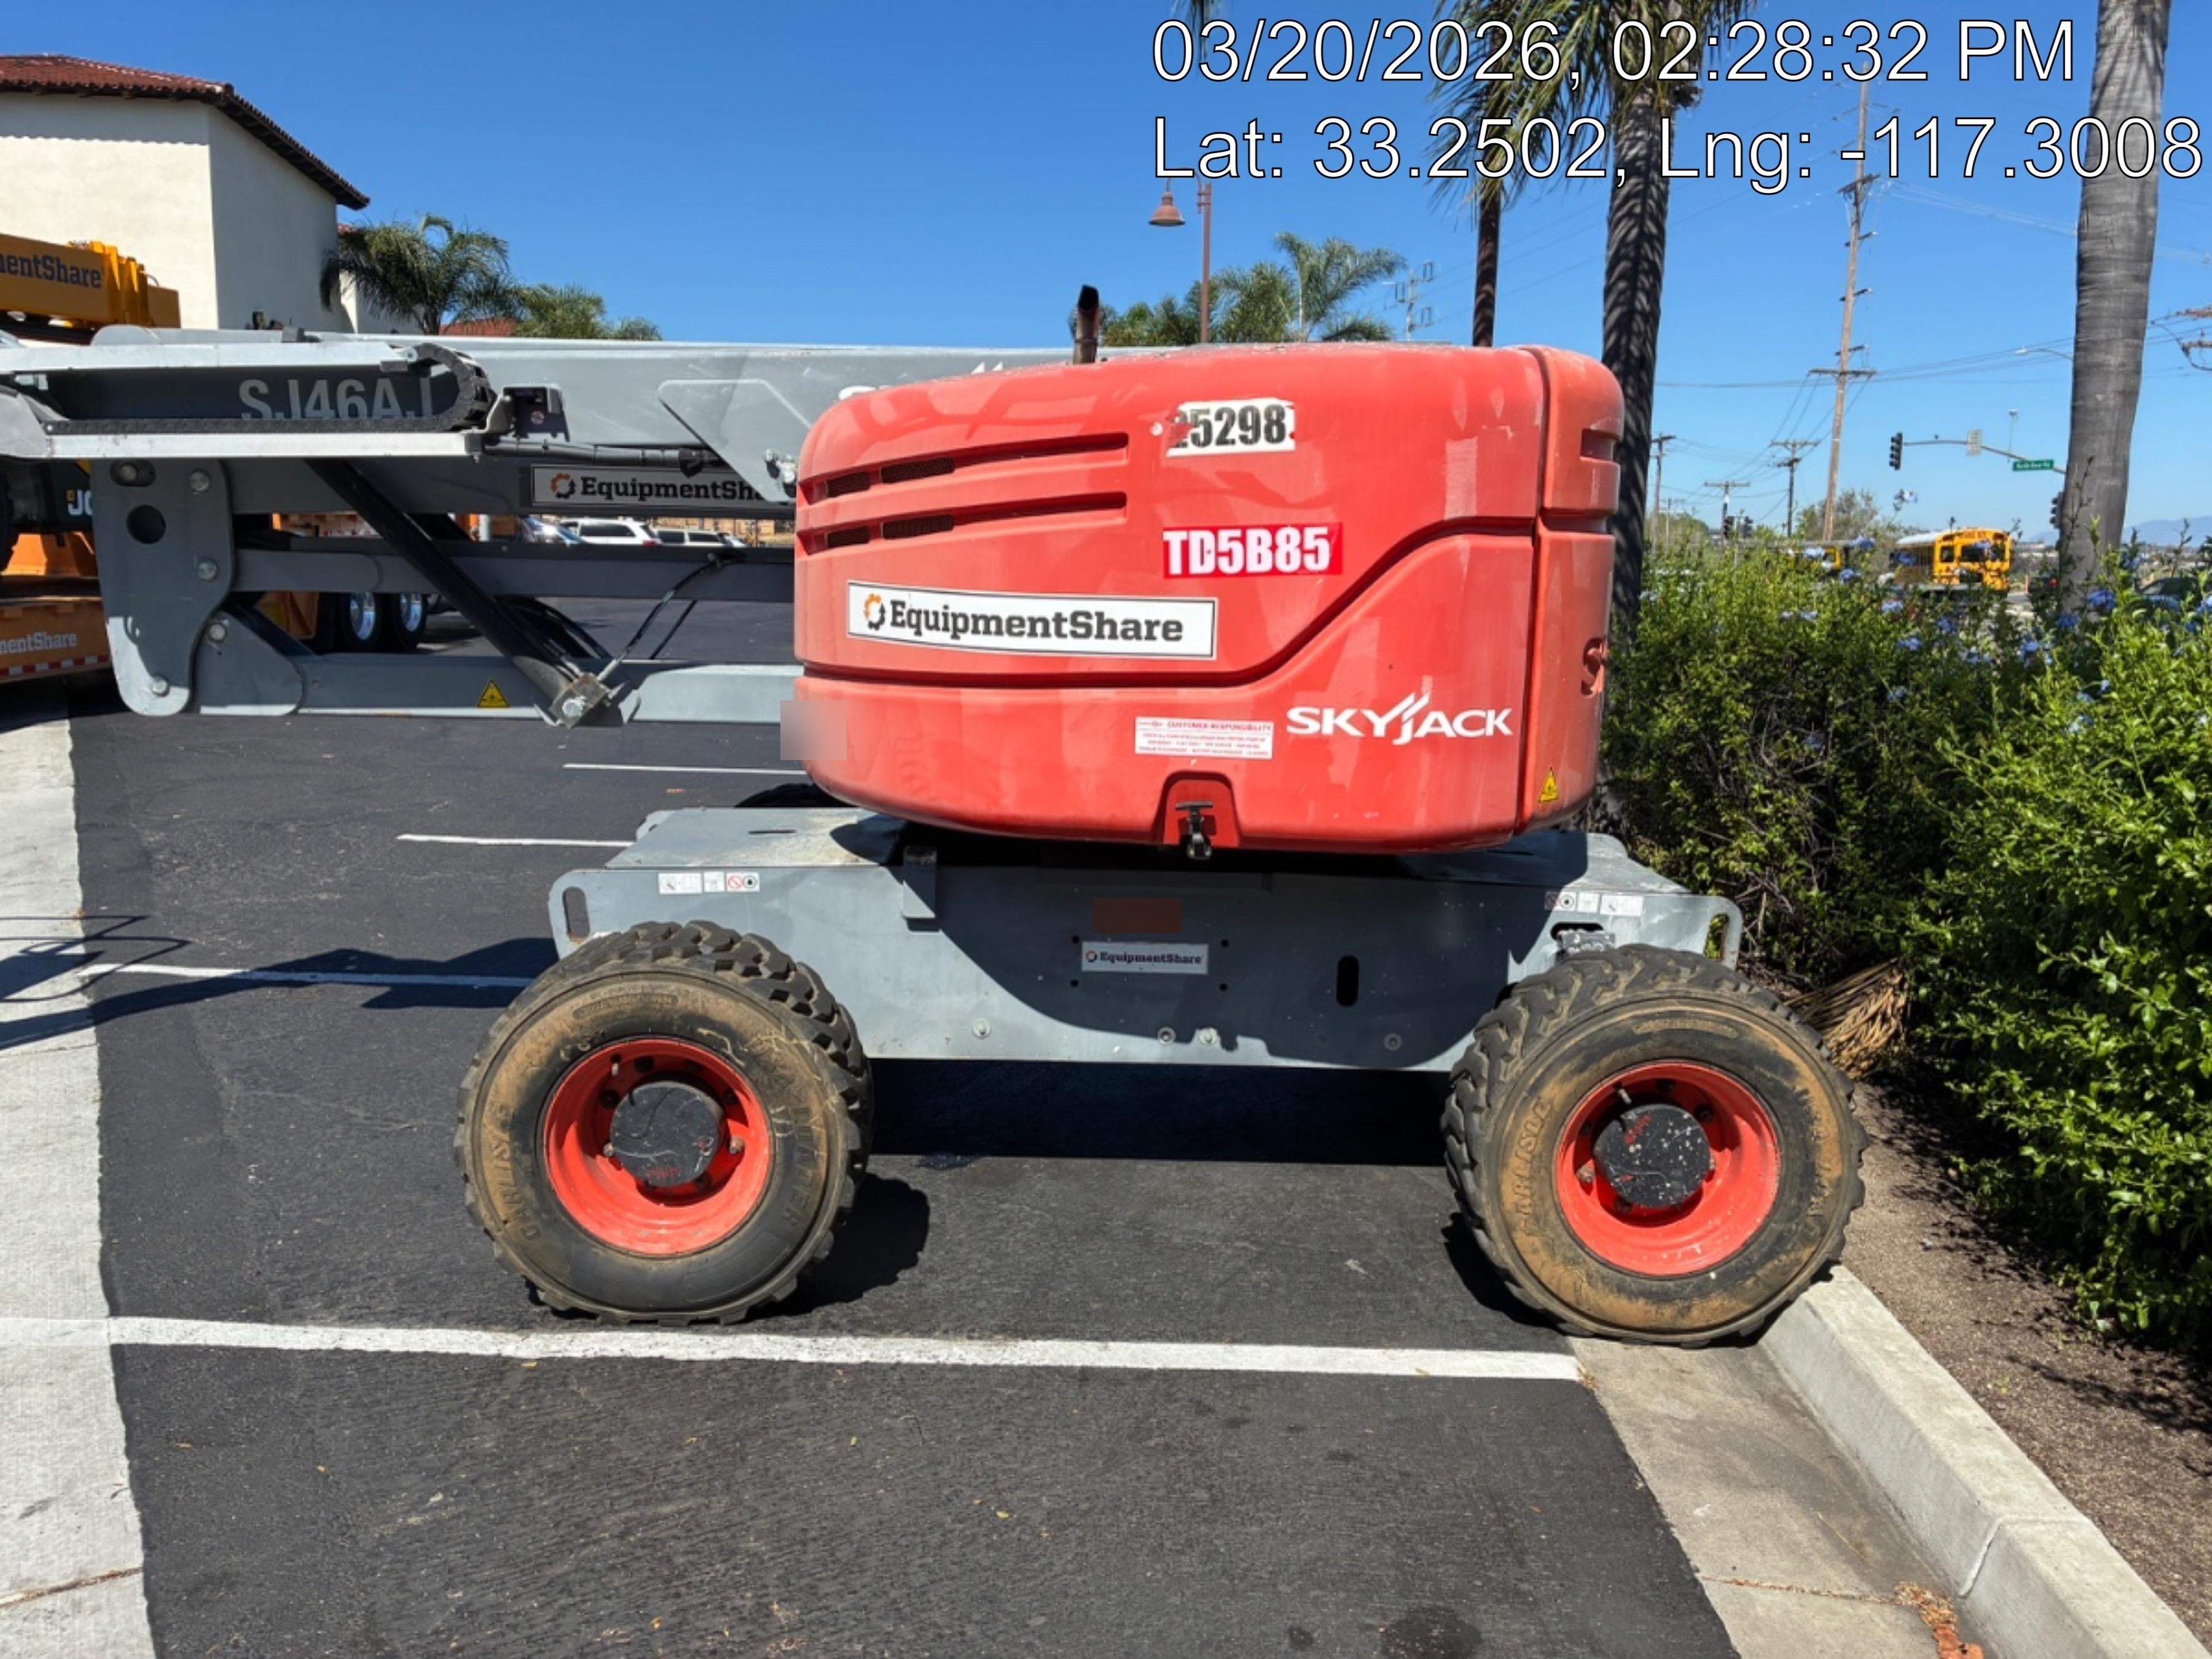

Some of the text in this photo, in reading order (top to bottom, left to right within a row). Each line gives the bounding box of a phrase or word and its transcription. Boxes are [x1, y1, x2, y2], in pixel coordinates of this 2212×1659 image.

[1163, 527, 1330, 575] TD5B85
[890, 599, 1183, 642] EquipmentShare
[1286, 692, 1513, 745] SKYJACK
[1100, 951, 1202, 964] EquipmentShare
